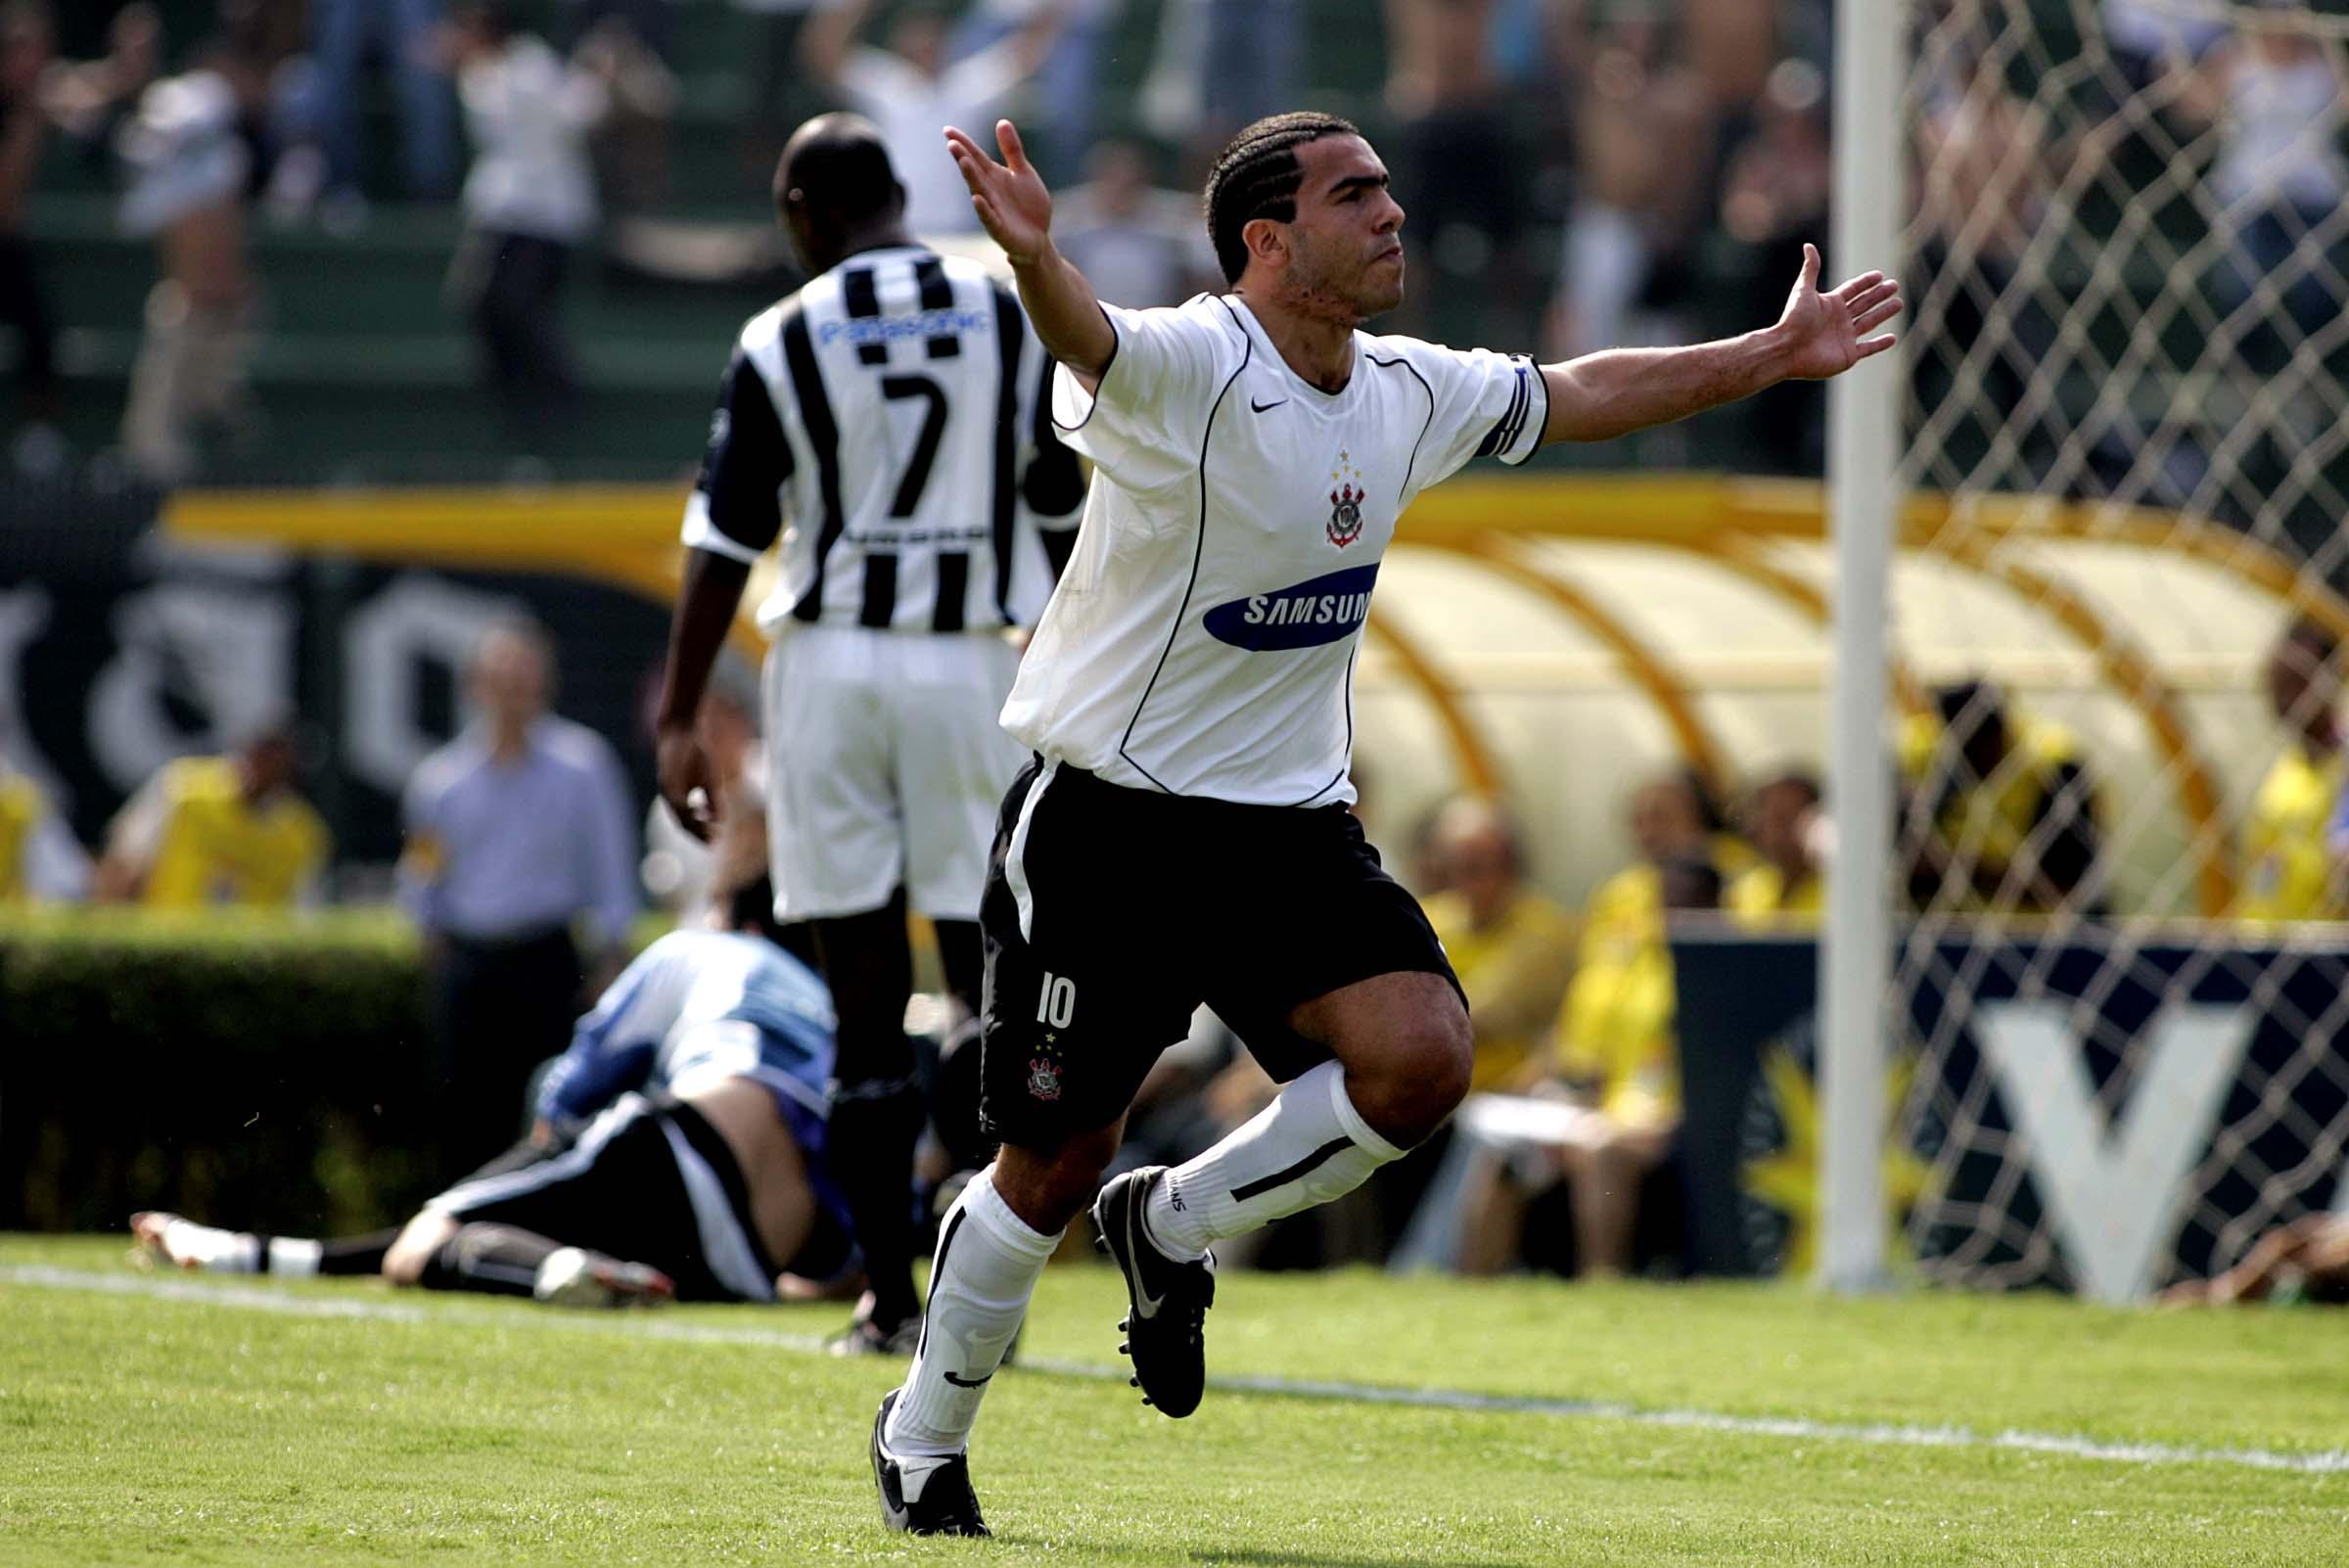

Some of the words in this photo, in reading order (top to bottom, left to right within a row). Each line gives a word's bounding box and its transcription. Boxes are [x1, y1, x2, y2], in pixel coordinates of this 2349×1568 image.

[819, 308, 989, 345] Panasonic
[881, 376, 948, 519] 7
[1244, 590, 1372, 625] SAMSUN
[1036, 971, 1076, 1029] 10
[1973, 998, 2349, 1306] V
